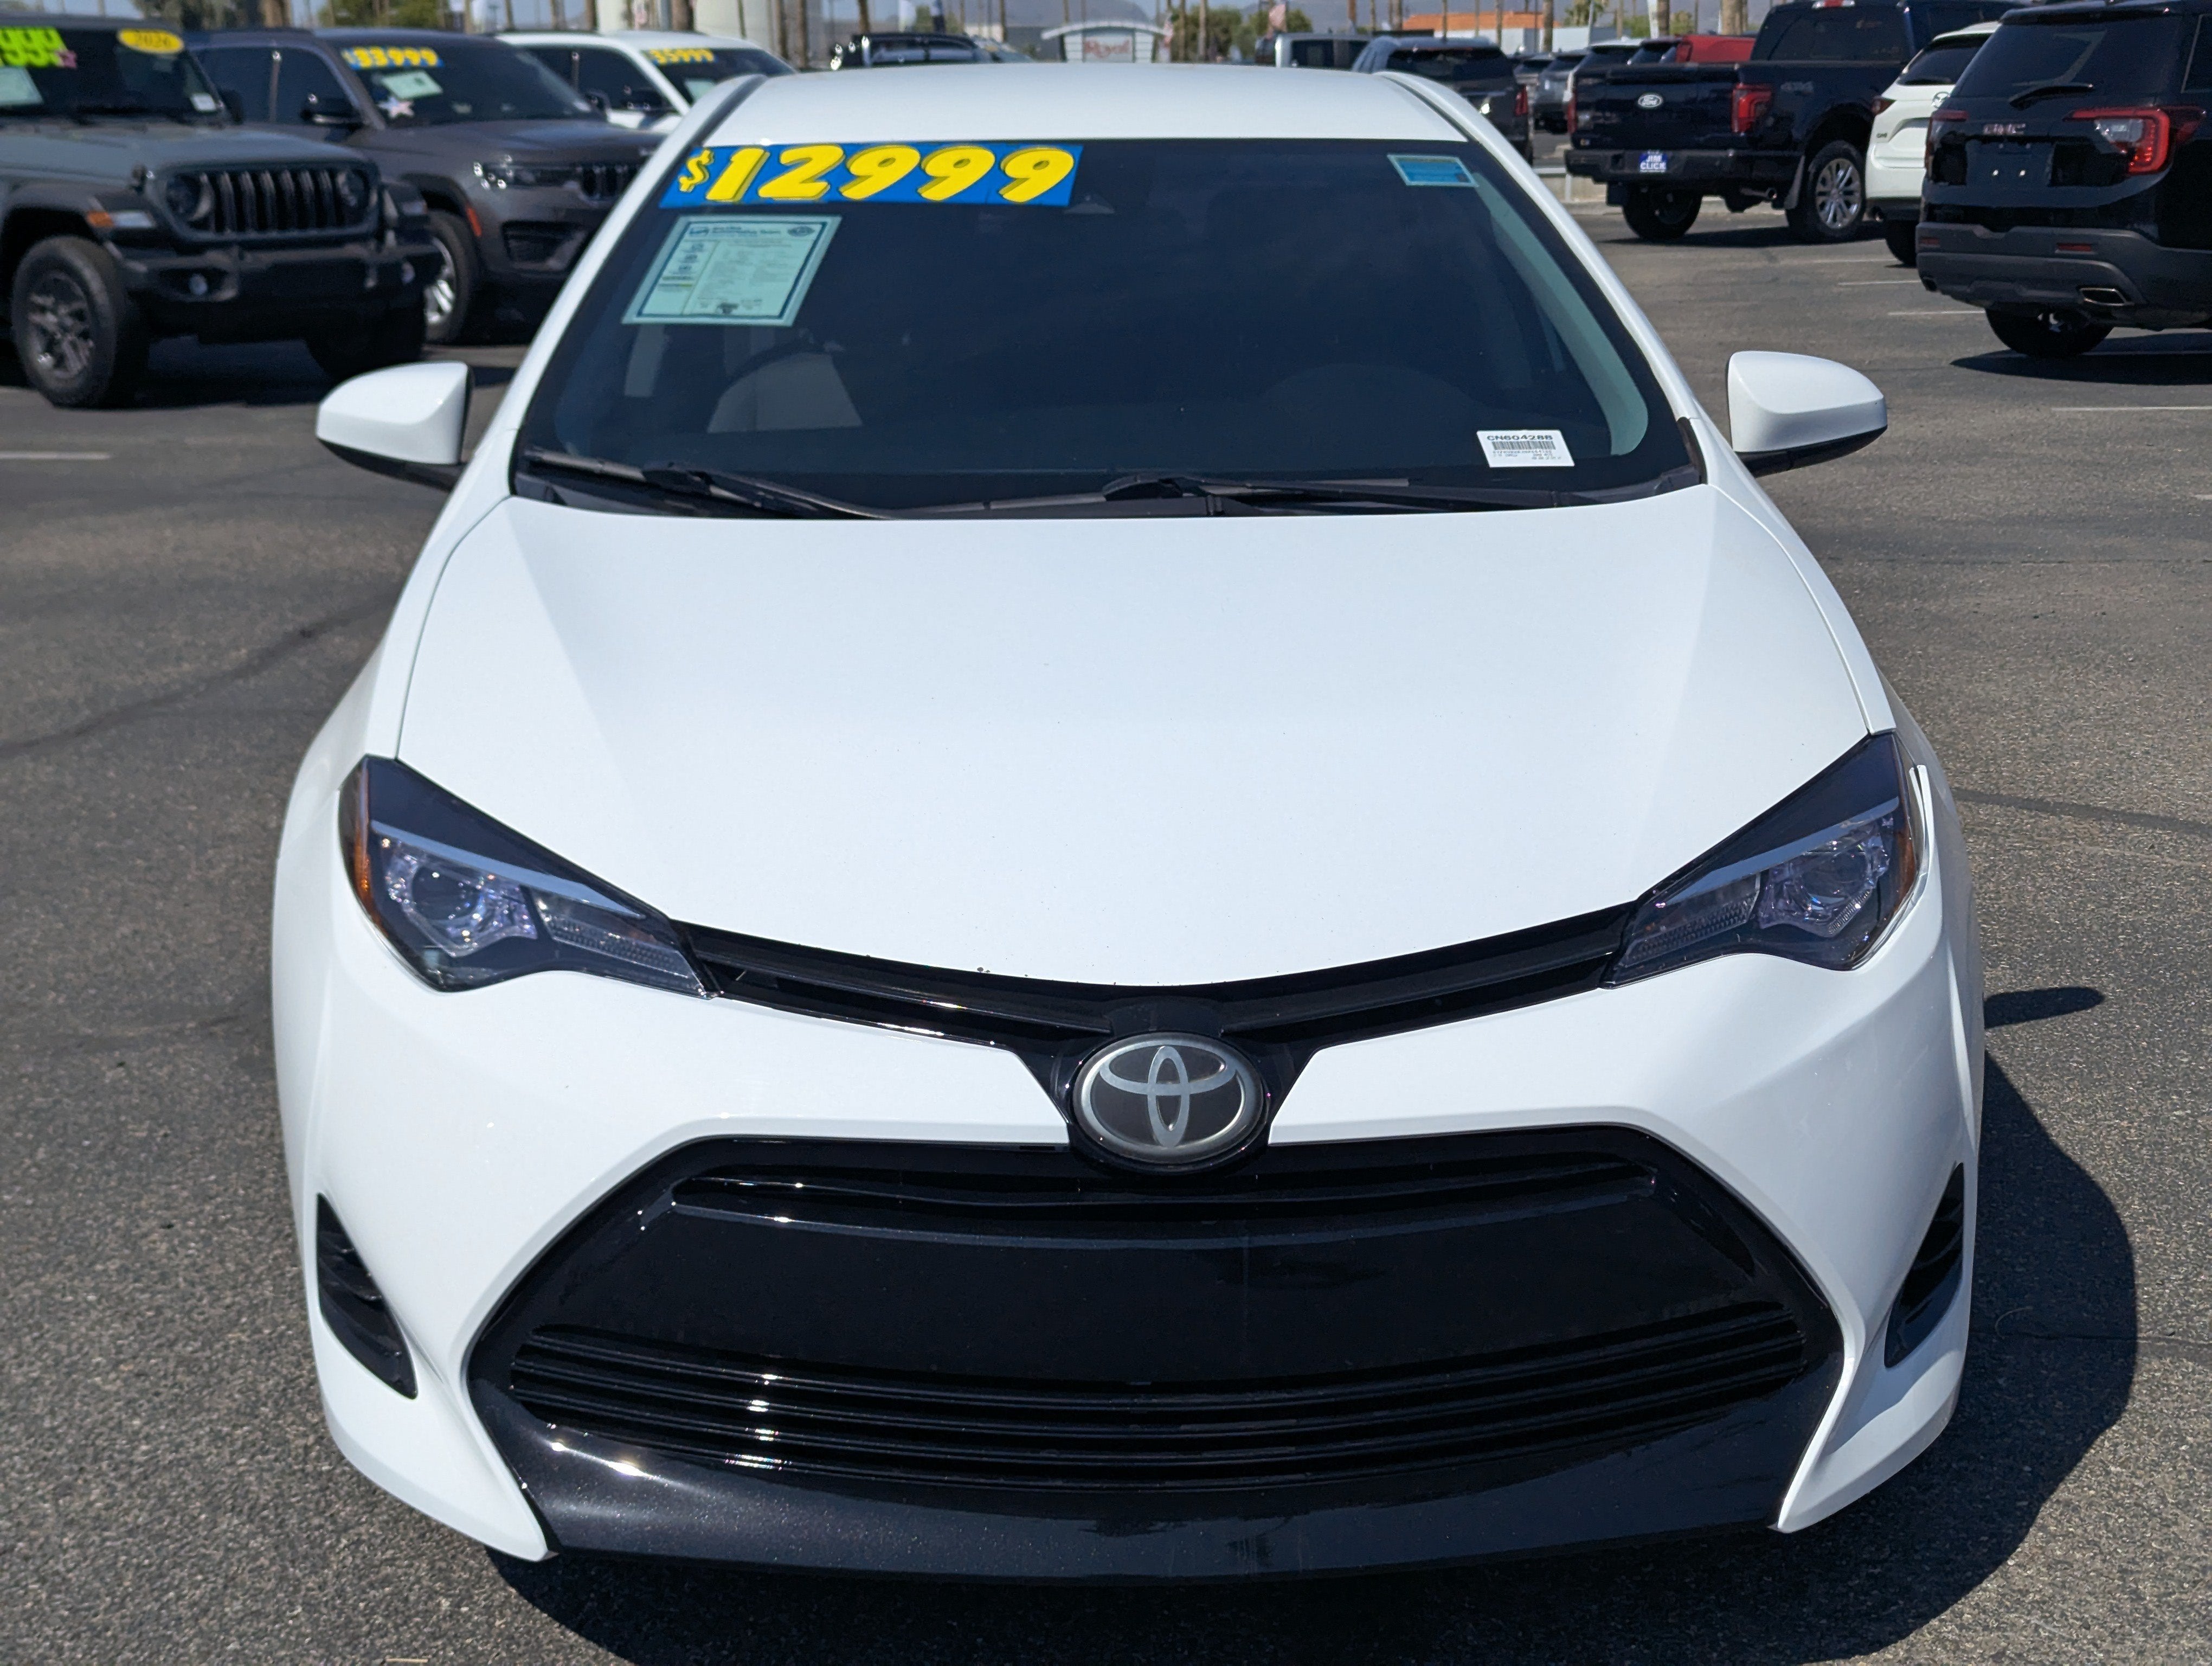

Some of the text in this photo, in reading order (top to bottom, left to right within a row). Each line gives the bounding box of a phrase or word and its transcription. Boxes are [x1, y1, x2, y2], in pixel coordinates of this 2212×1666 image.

[1983, 124, 2026, 135] GMC
[1640, 162, 1667, 170] CLICK
[679, 144, 1075, 203] $12999
